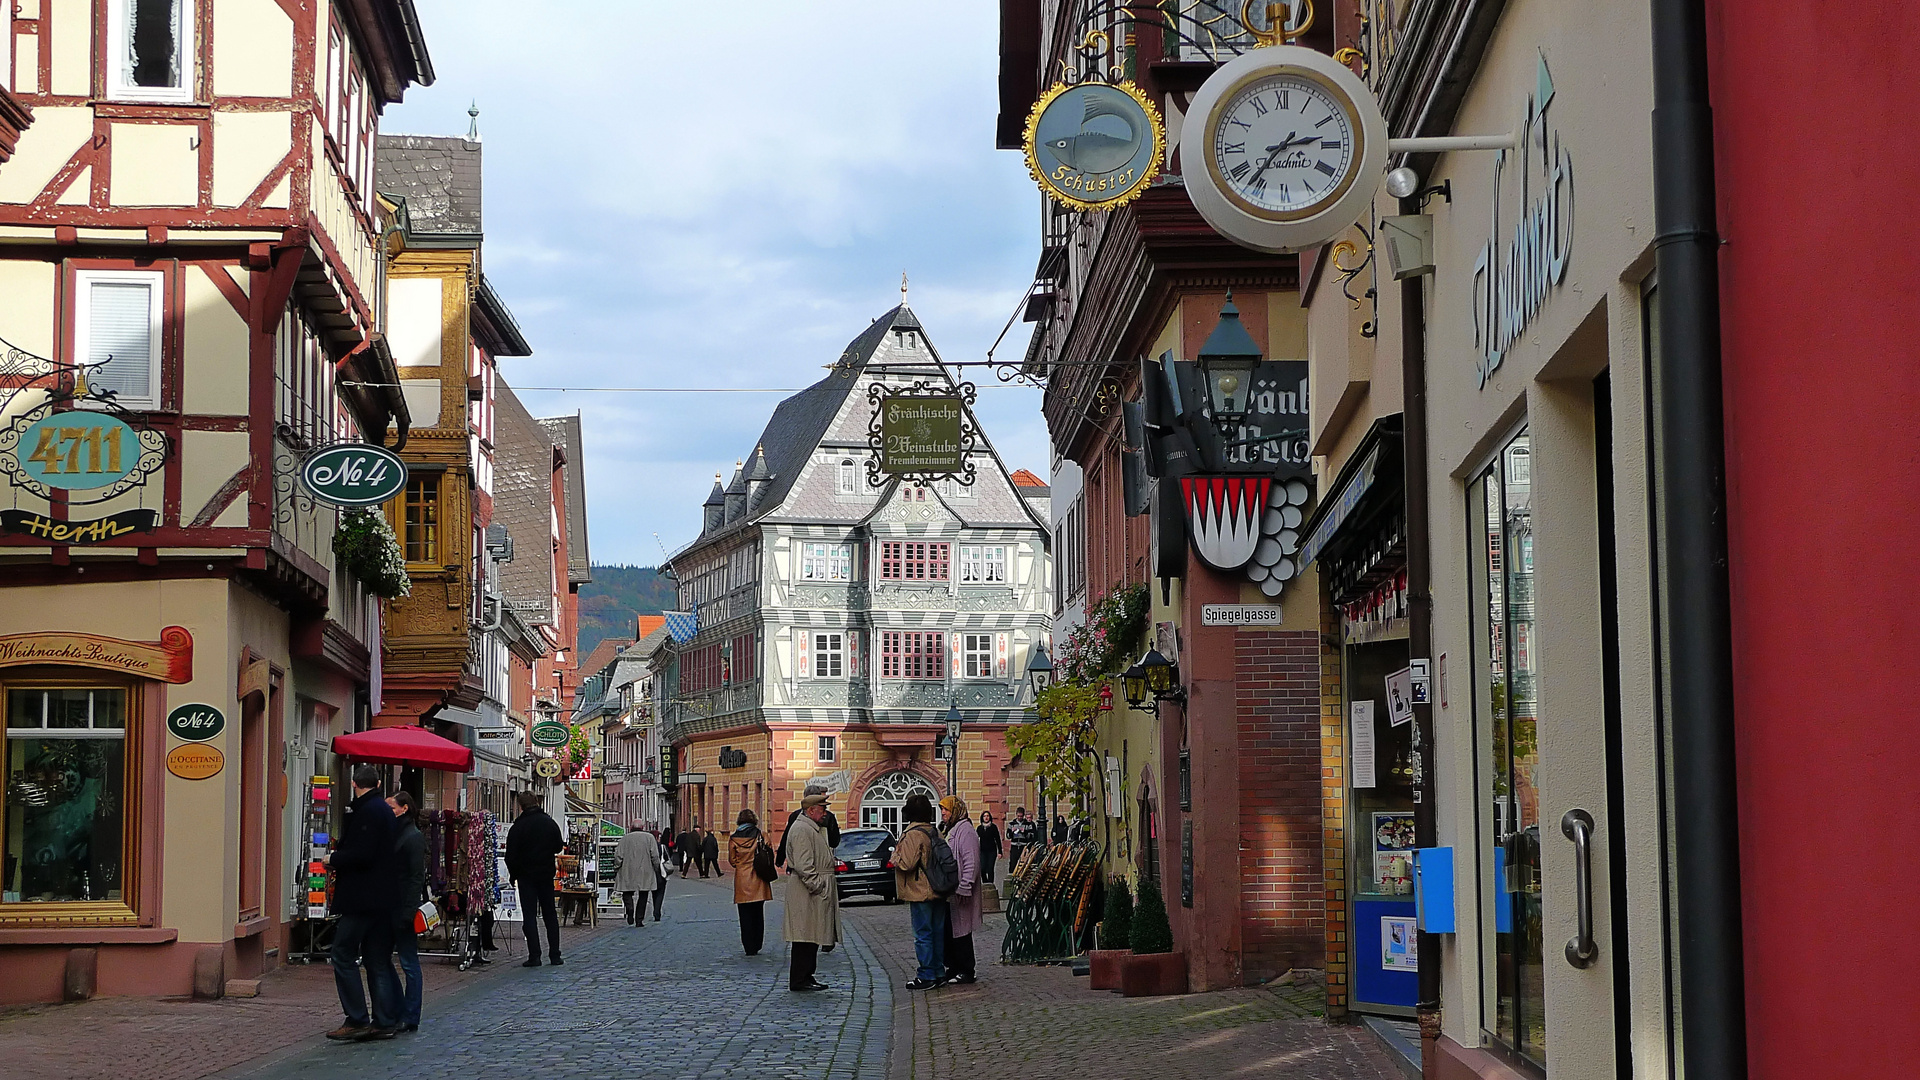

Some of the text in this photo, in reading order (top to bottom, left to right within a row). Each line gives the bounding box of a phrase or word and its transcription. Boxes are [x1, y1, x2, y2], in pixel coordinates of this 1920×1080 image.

[1248, 96, 1269, 118] XI
[1274, 90, 1289, 110] XII
[1231, 116, 1252, 132] X
[1314, 114, 1333, 129] II
[1225, 142, 1245, 154] IX
[1321, 141, 1341, 149] III
[1052, 165, 1134, 193] Schuster
[1303, 179, 1316, 196] V
[1280, 184, 1290, 203] VI
[888, 404, 957, 424] Fränkische
[28, 427, 123, 475] 4711
[887, 435, 957, 453] Weinstube
[888, 455, 957, 465] Fremdenzimmer
[366, 457, 388, 486] 4
[20, 519, 135, 544] Herth
[1204, 607, 1277, 624] Spiegelgasse
[0, 641, 149, 669] Weihnachts-Boutique
[203, 713, 216, 728] 4
[170, 756, 221, 764] L'OCCITANE
[662, 746, 671, 785] HOTEL
